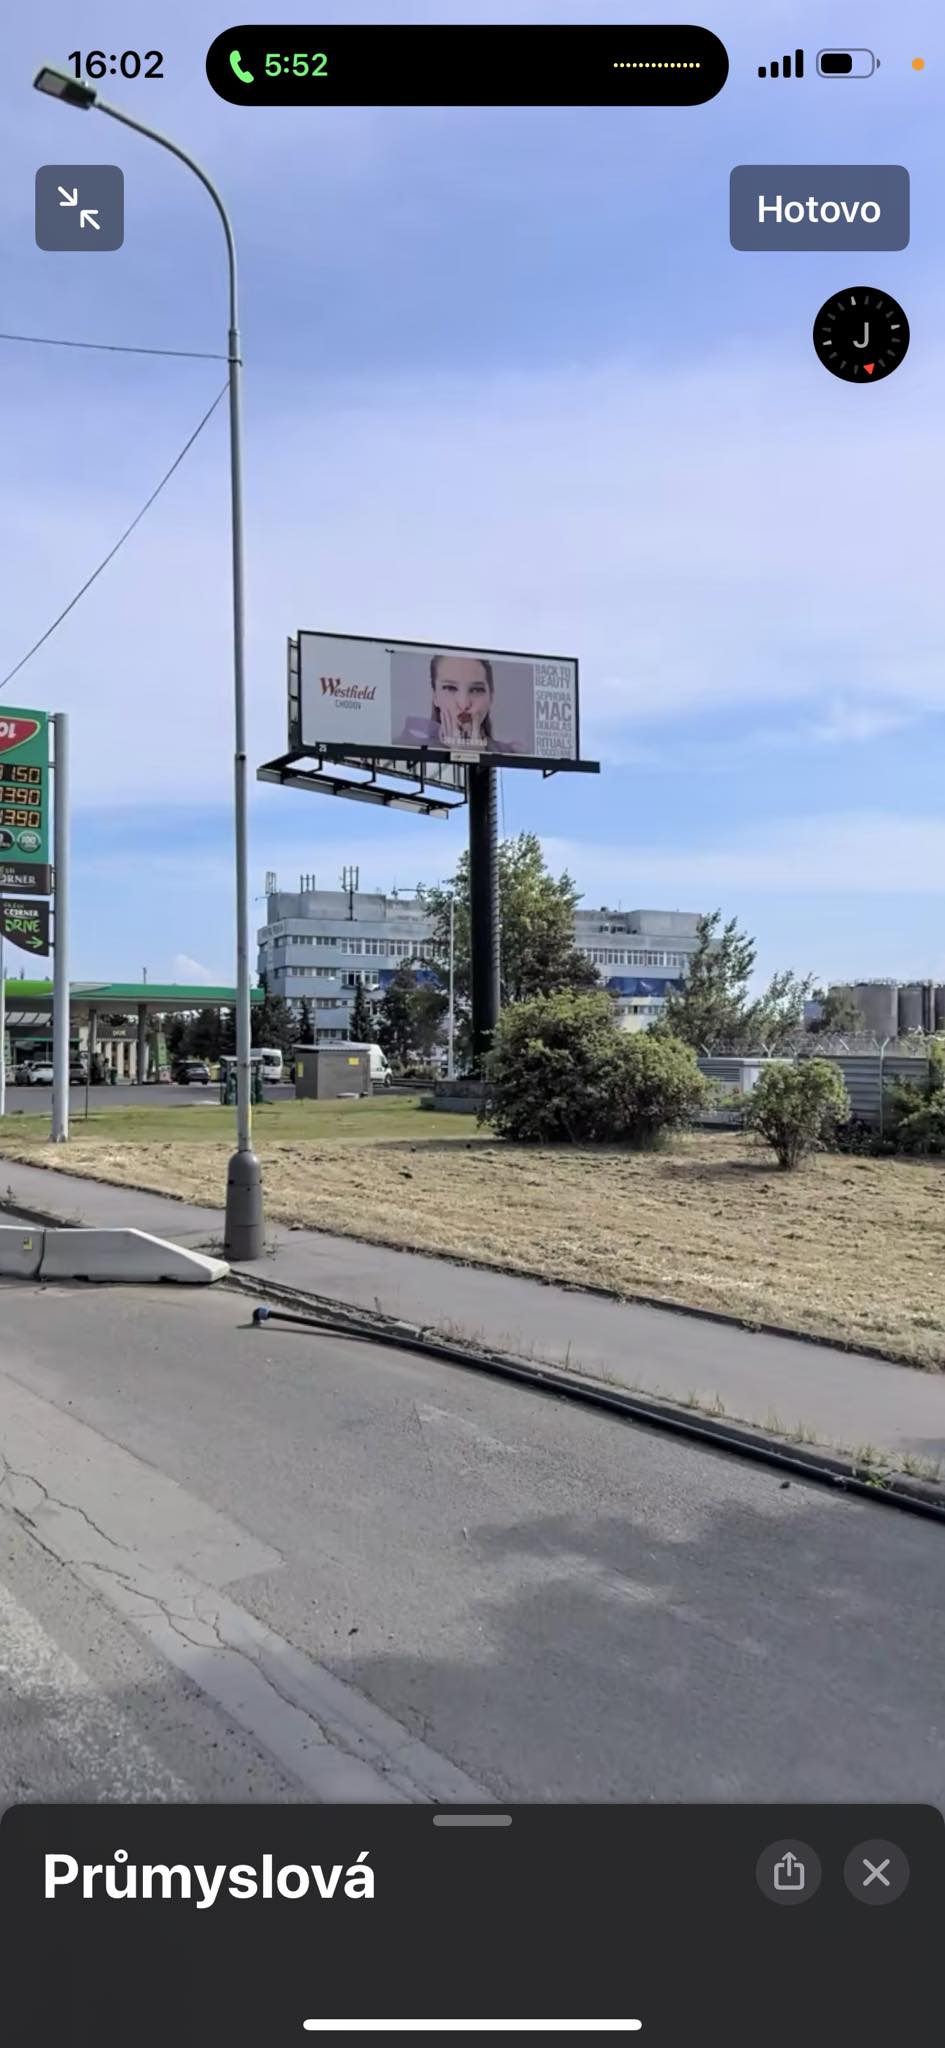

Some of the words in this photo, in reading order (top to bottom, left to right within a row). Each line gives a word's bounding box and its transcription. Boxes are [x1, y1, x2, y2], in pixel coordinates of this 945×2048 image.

[320, 676, 377, 700] Westfield
[535, 675, 570, 688] BEAUTY
[536, 701, 572, 721] MAC
[0, 765, 40, 783] 150
[0, 787, 40, 805] 390
[0, 810, 40, 827] 390
[5, 919, 40, 933] DRIVE
